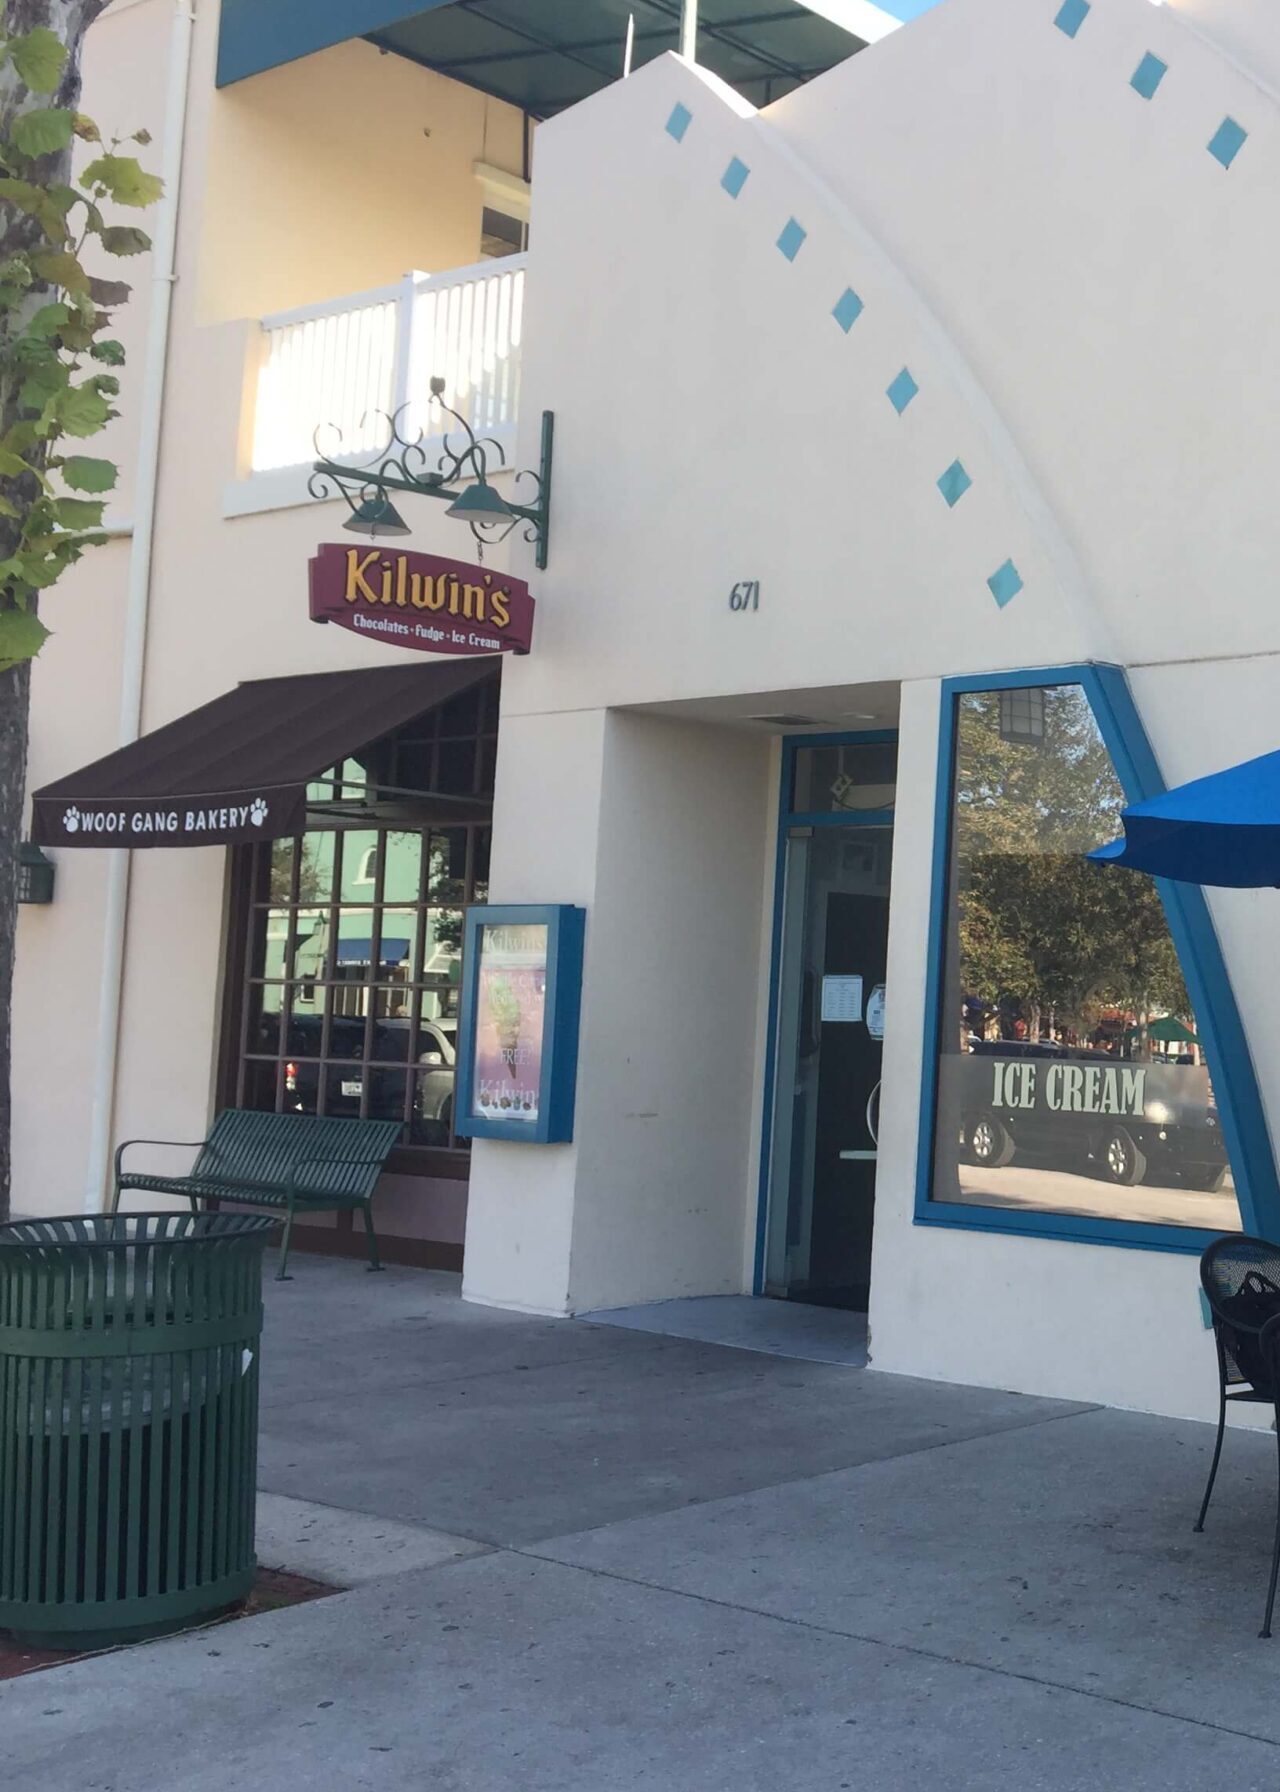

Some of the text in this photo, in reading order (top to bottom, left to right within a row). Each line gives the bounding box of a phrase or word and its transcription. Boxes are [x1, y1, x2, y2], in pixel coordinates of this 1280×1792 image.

[345, 548, 511, 629] Kilwin's
[729, 580, 760, 611] 671
[353, 613, 500, 650] Chocolates Fudge Ice Cream
[81, 806, 249, 833] WOOF GANG BAKERY
[992, 1062, 1147, 1116] ICE CREAM
